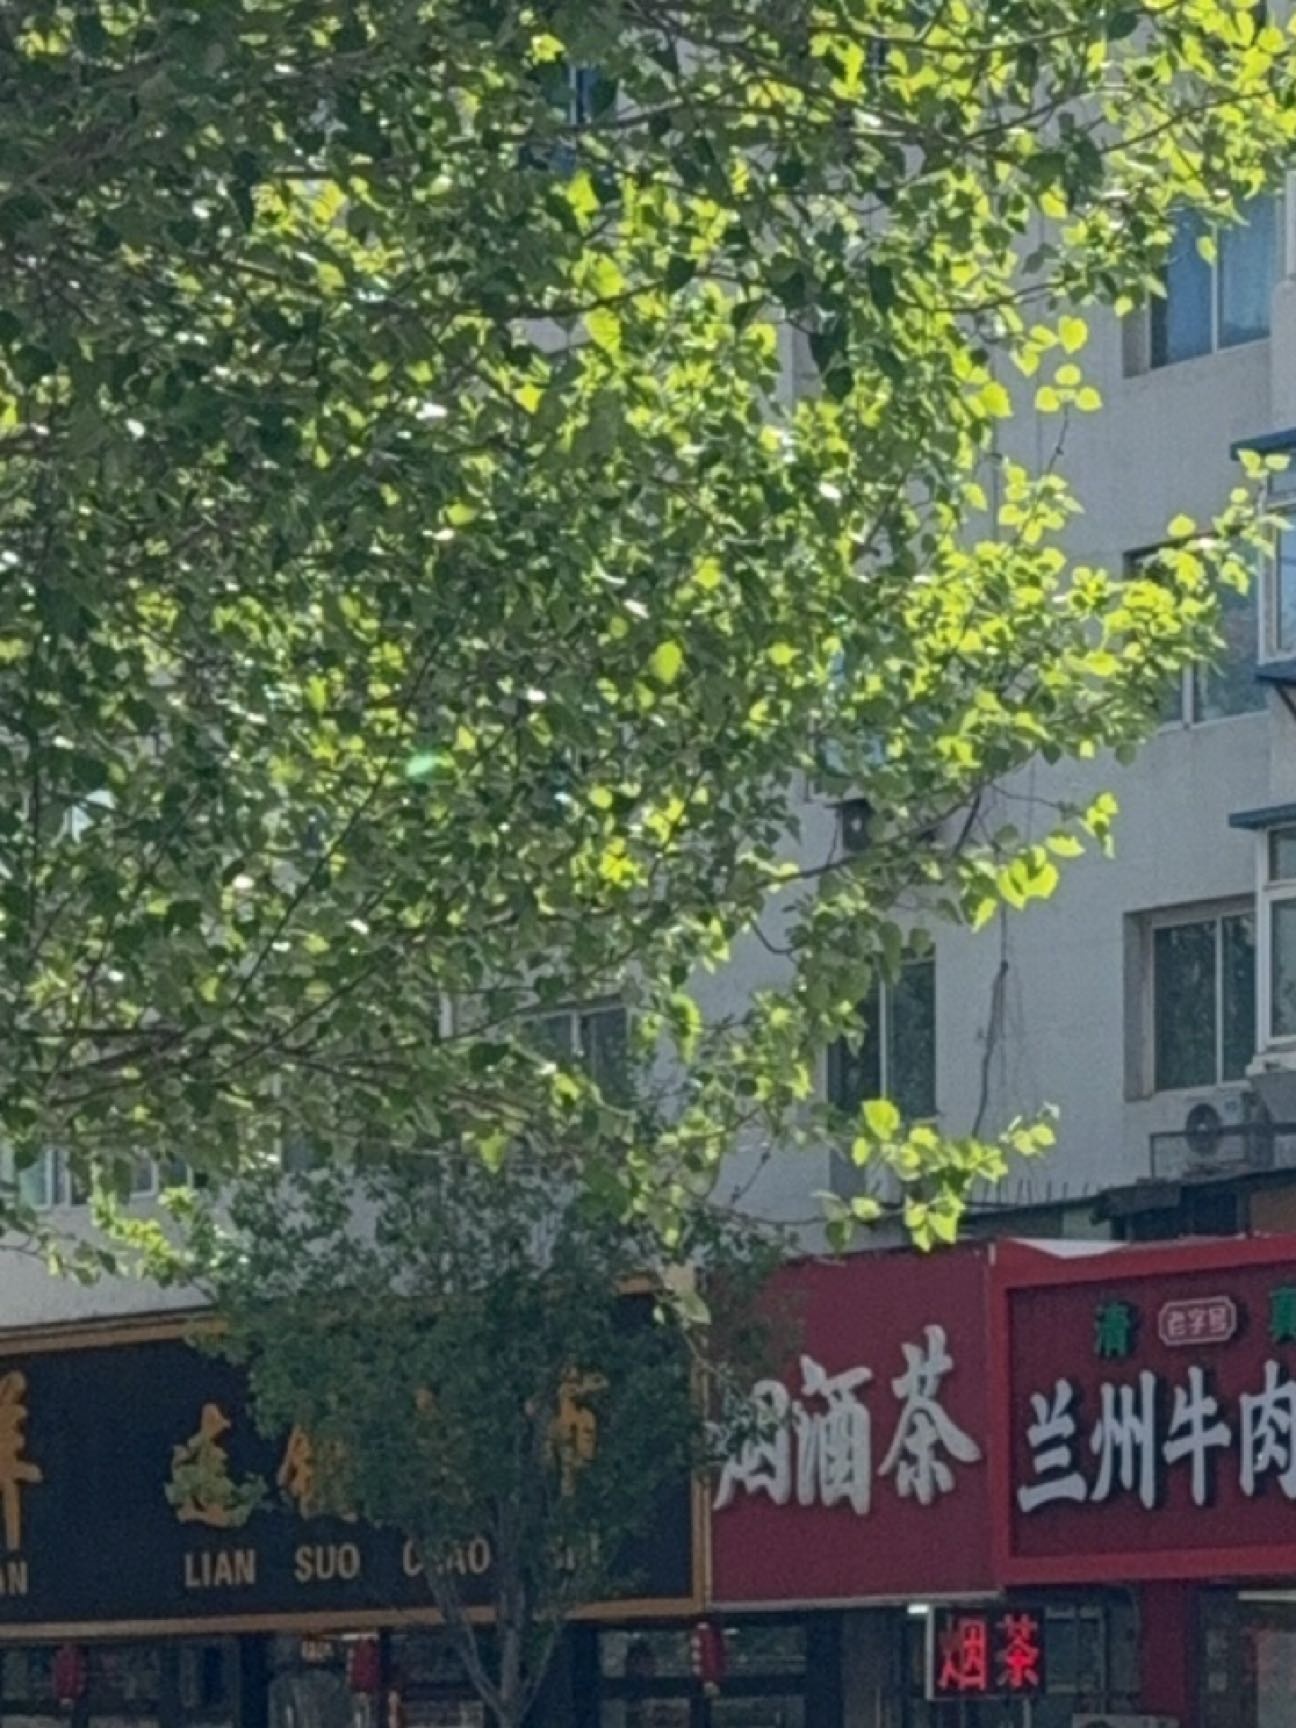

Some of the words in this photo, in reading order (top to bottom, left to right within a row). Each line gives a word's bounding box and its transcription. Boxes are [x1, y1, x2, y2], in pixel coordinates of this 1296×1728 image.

[1093, 1299, 1133, 1358] 清
[184, 1548, 257, 1588] LIAN
[294, 1542, 361, 1582] SUO
